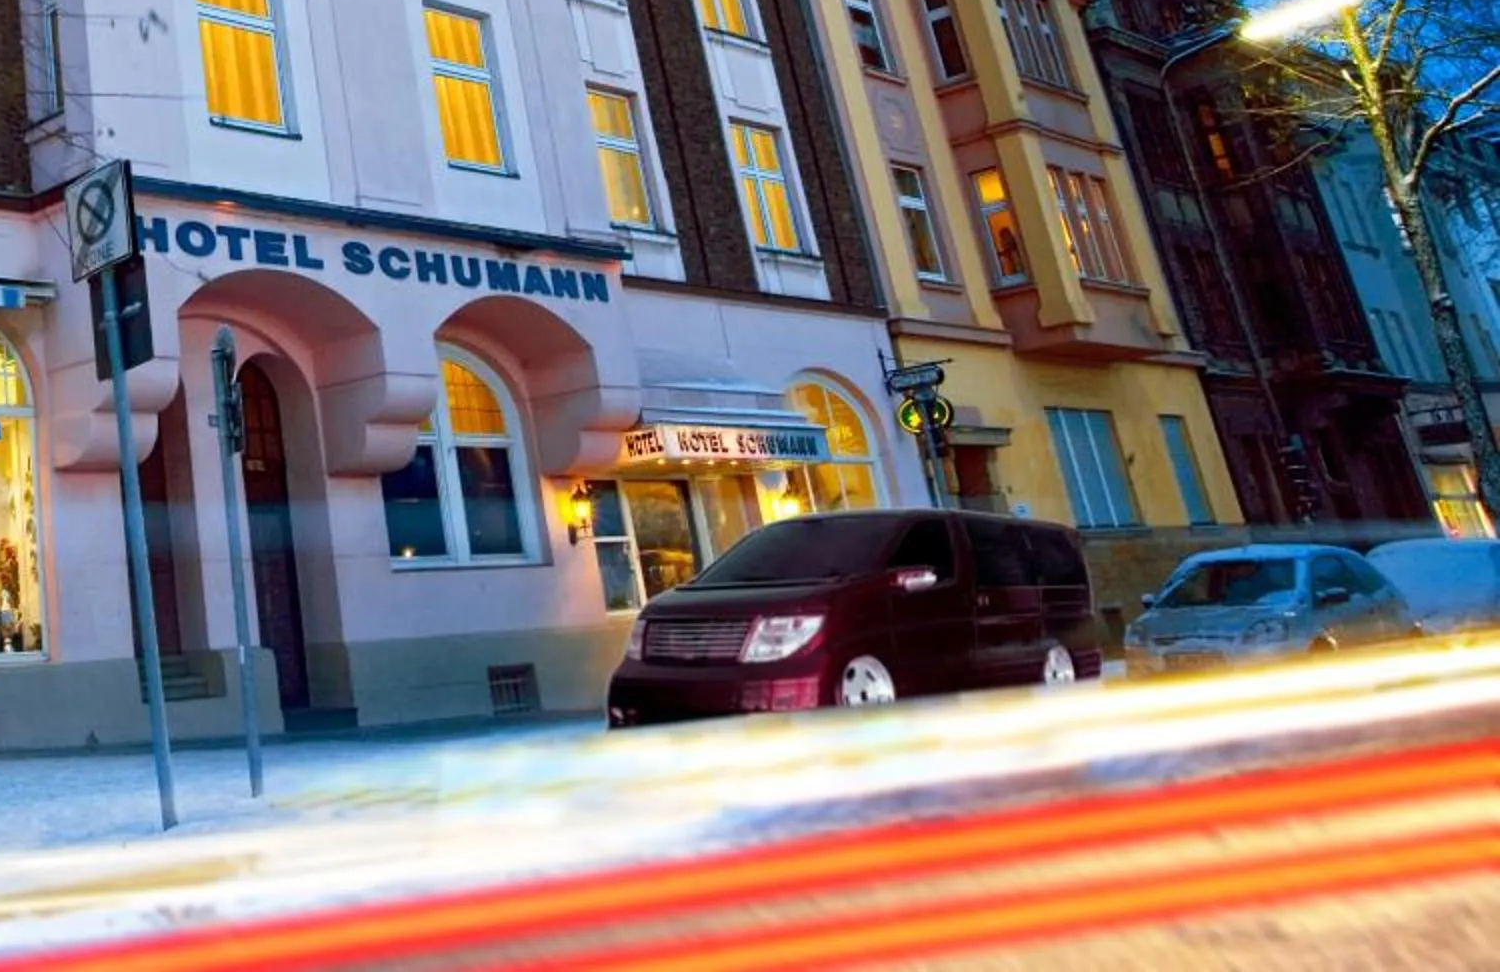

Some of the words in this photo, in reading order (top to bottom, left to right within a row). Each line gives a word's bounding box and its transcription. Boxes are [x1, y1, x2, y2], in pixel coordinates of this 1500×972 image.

[136, 215, 324, 270] HOTEL
[342, 241, 609, 303] SCHUMANN
[677, 431, 728, 454] HOTEL
[737, 433, 819, 456] SCHUMANN
